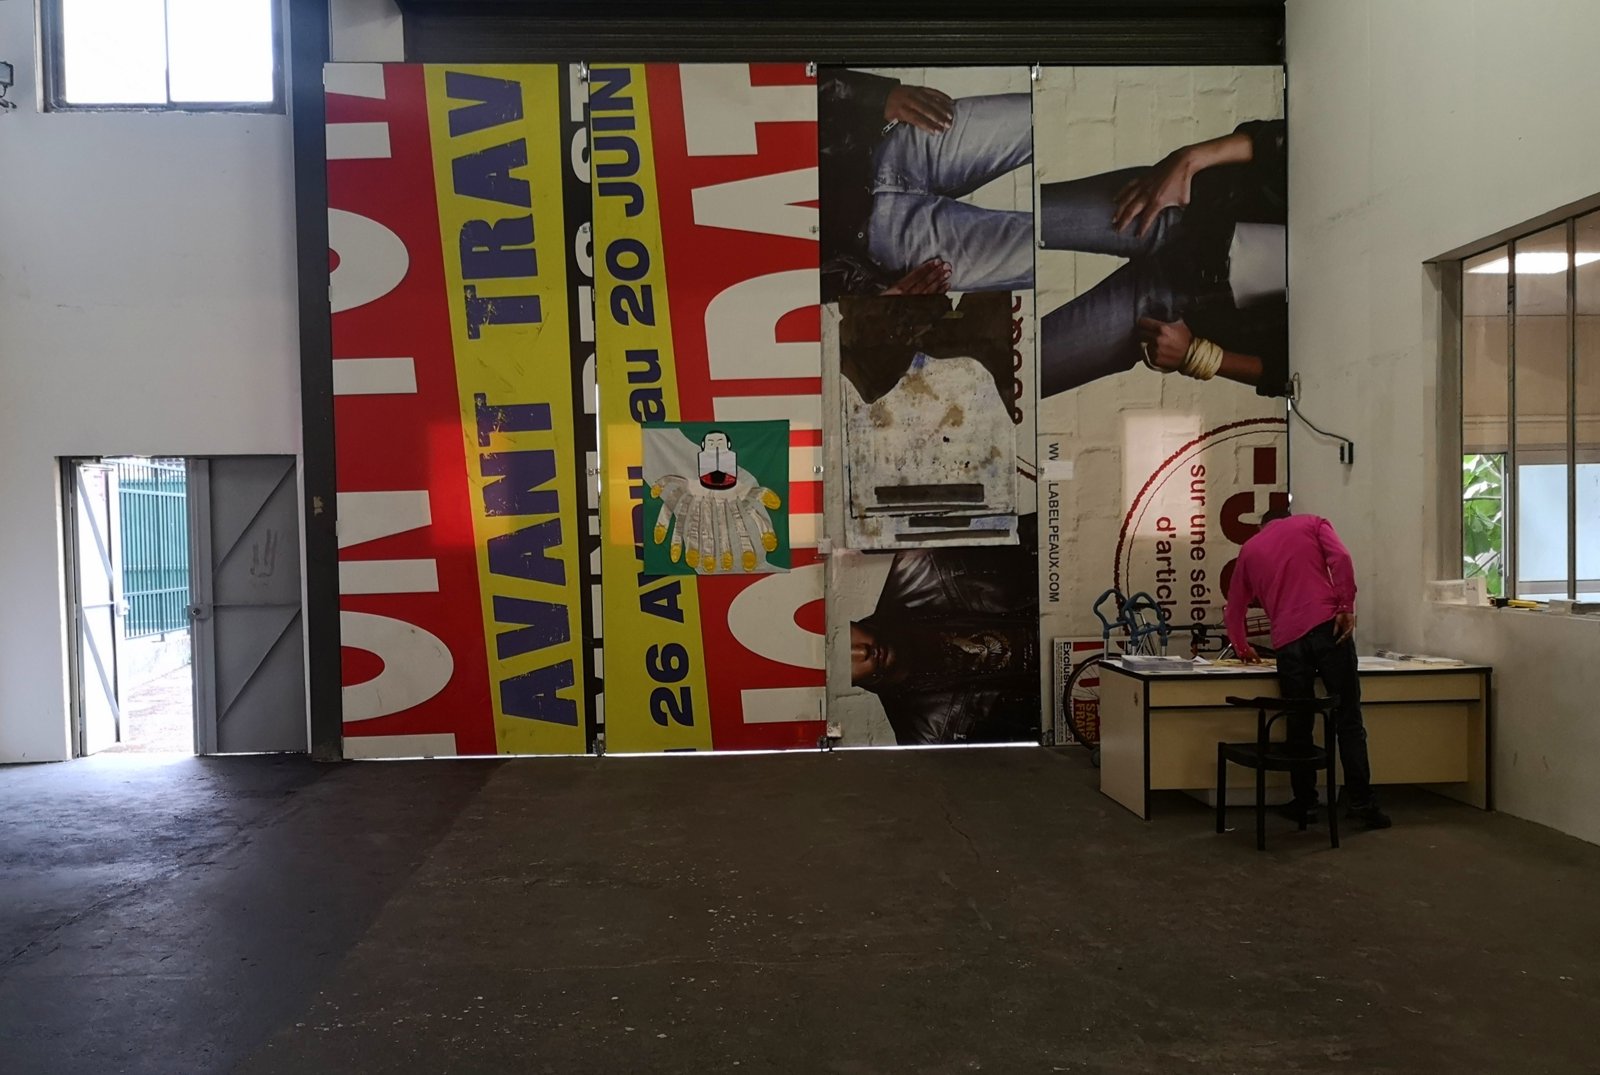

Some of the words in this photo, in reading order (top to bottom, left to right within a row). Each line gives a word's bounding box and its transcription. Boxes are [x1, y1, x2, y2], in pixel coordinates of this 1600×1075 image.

[590, 66, 645, 218] JUIN
[445, 70, 543, 339] TRAV
[606, 238, 656, 328] 20
[624, 349, 665, 422] au
[1048, 442, 1060, 603] W.LABELPEAUX.COM
[1190, 464, 1206, 506] sur
[473, 392, 578, 728] AVANT
[1190, 514, 1206, 561] une
[645, 643, 696, 728] 26
[1086, 703, 1097, 740] SANS
